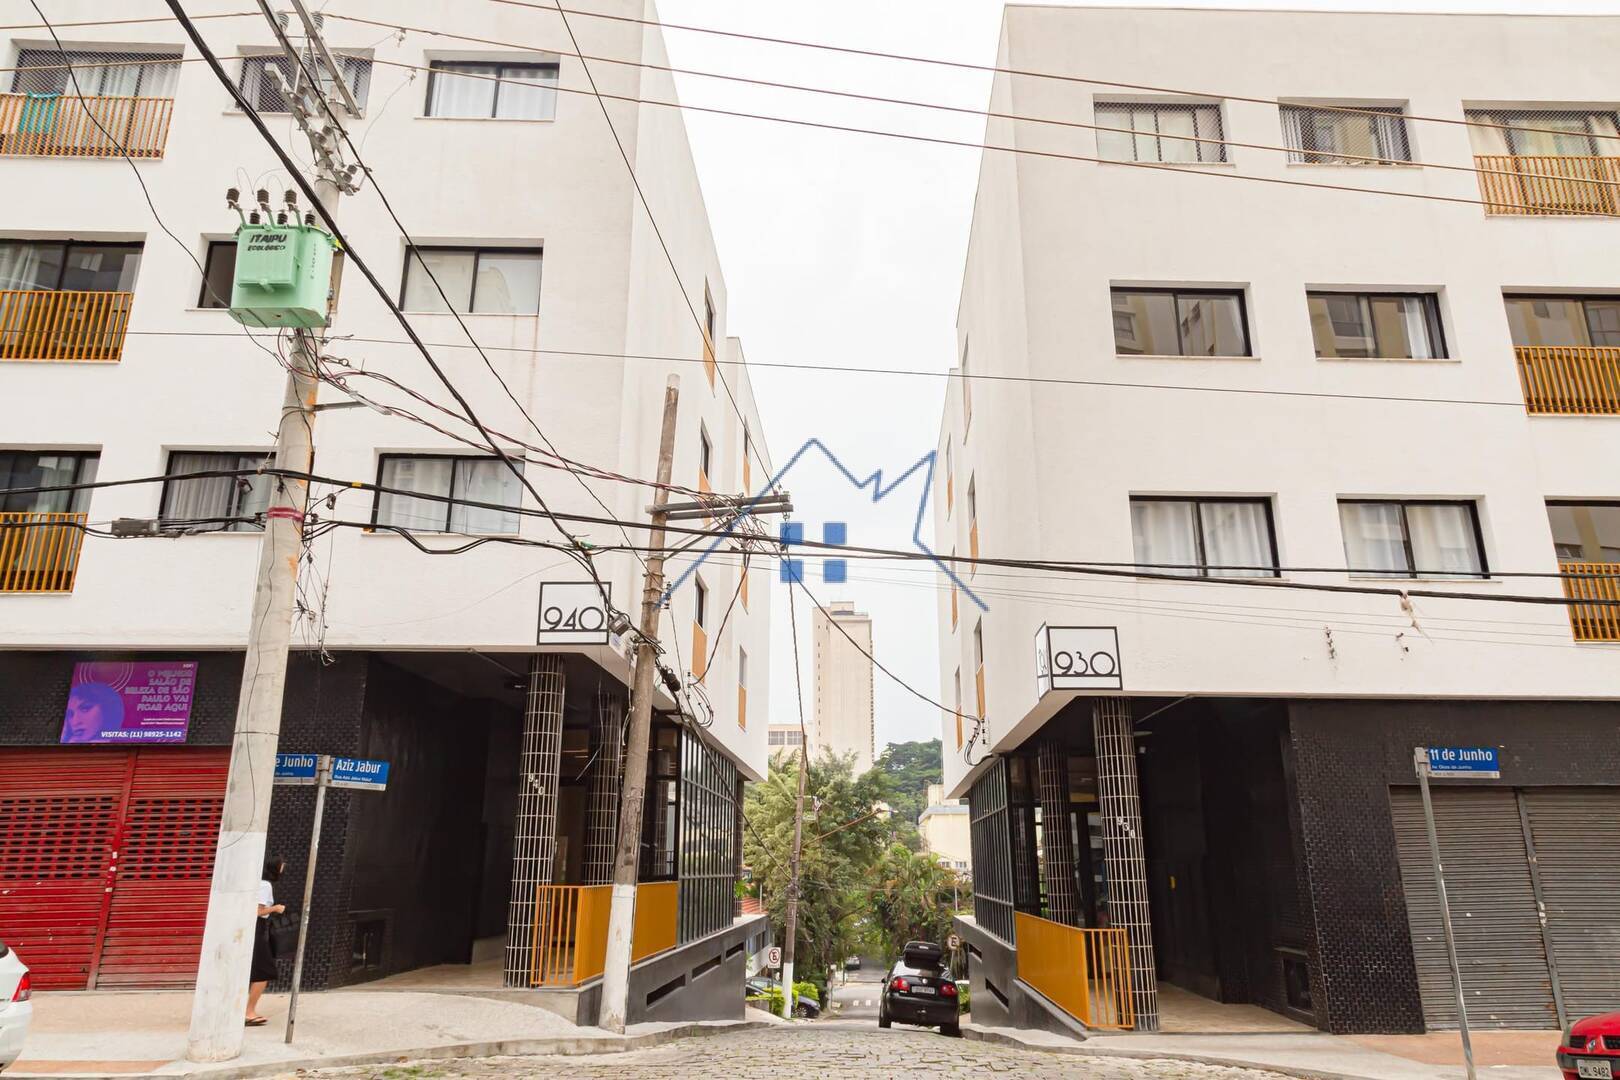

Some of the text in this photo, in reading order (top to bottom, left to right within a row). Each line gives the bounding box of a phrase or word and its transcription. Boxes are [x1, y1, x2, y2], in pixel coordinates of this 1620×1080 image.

[249, 234, 287, 243] ITAIPU
[544, 606, 604, 631] 940
[1054, 651, 1116, 675] 930
[149, 677, 176, 686] SALÃO
[172, 685, 190, 694] SÃO
[141, 695, 189, 703] PAULO VAI
[137, 703, 188, 713] FICAR AQUI
[130, 731, 142, 739] (11)
[1430, 748, 1493, 761] 11 de Junho
[282, 755, 314, 768] Junho
[336, 759, 382, 774] Aziz Jabur
